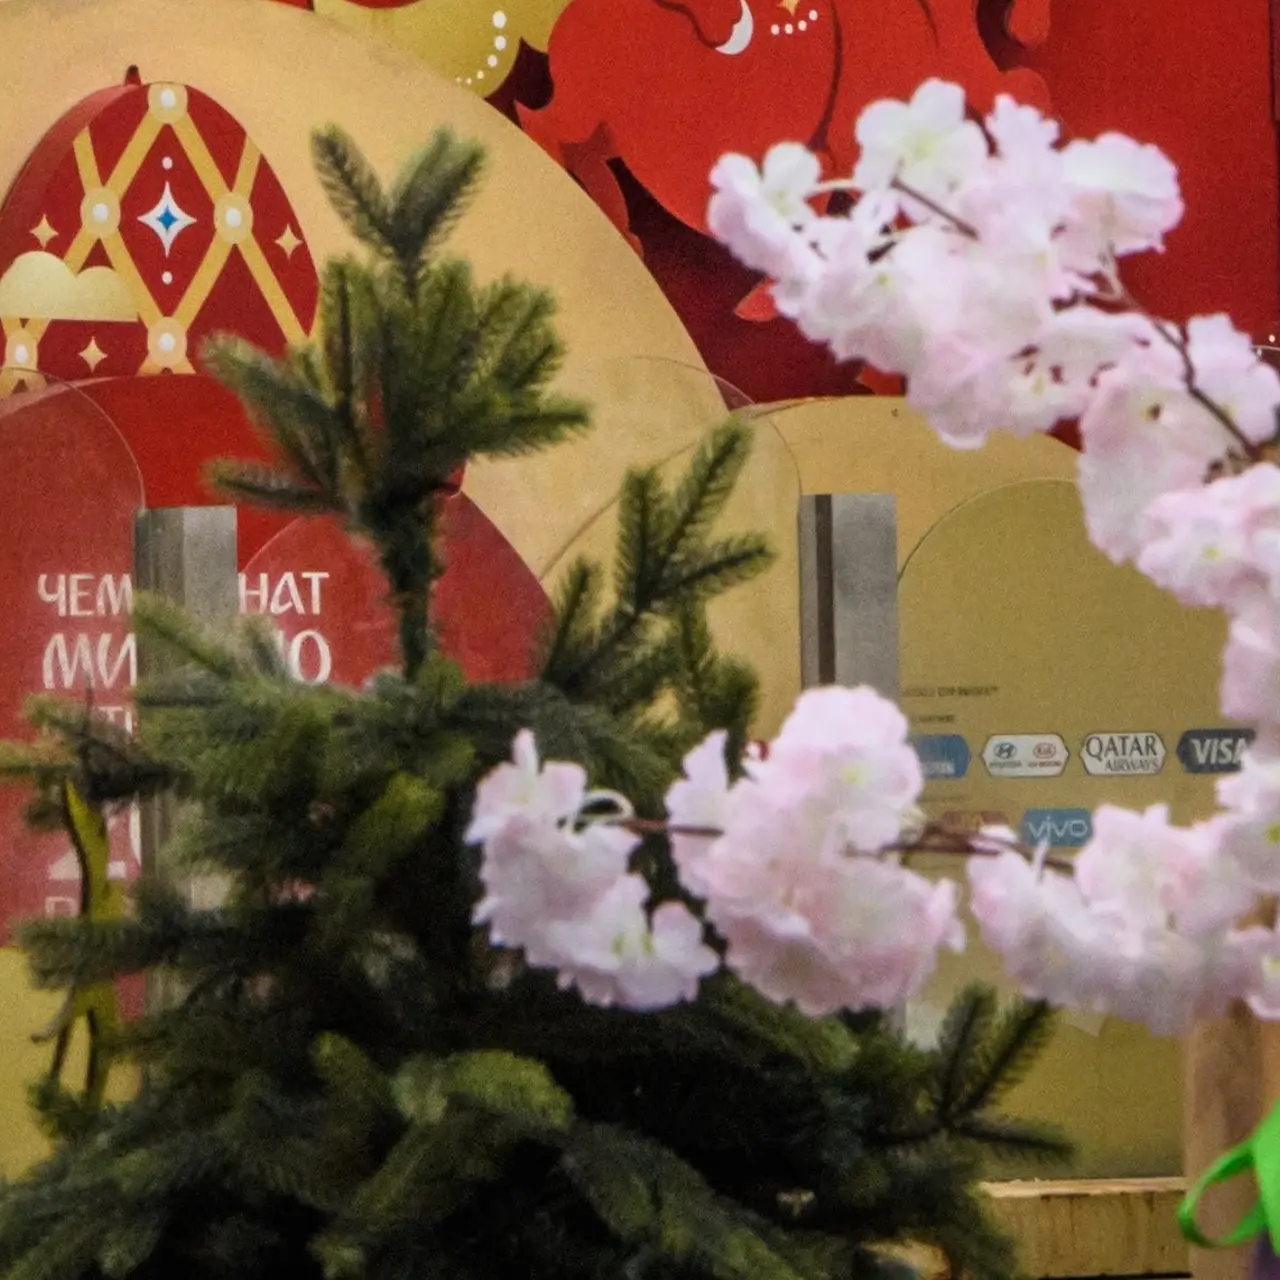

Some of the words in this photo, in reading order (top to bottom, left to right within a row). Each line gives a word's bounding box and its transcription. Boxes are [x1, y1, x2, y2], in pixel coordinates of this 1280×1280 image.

[37, 571, 330, 618] ЧЕМНАТ
[1085, 735, 1158, 762] QATAR
[1104, 758, 1160, 773] AIRWAYS
[1027, 815, 1089, 842] vivo
